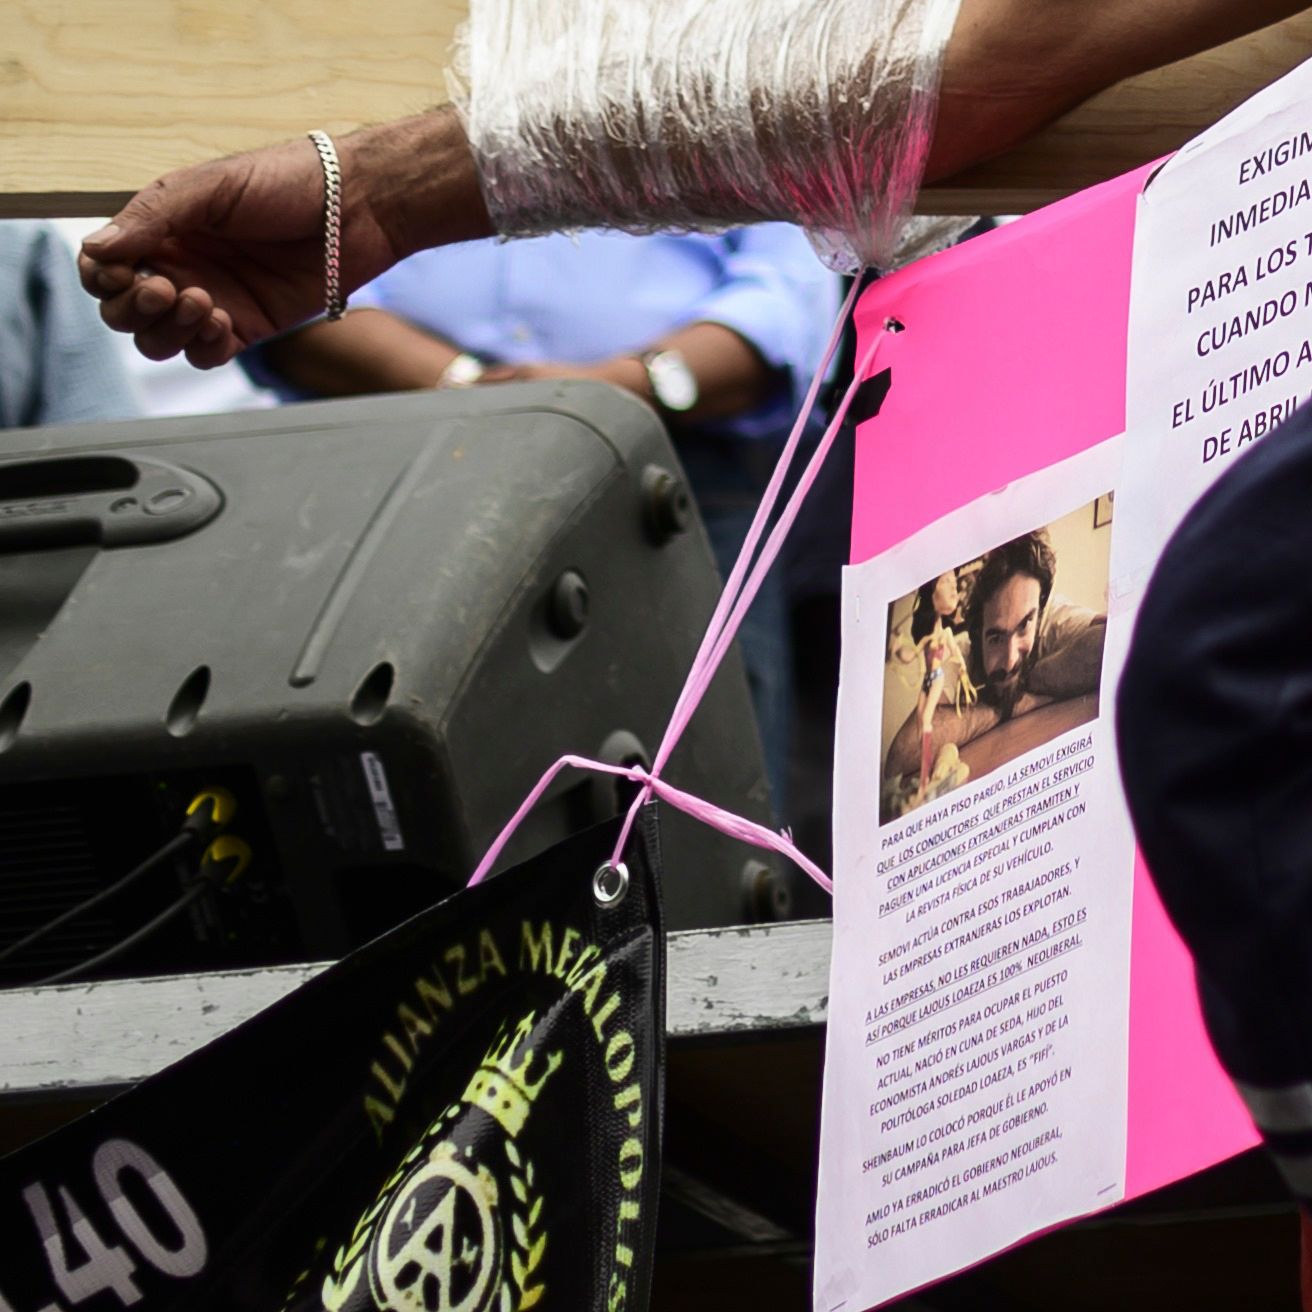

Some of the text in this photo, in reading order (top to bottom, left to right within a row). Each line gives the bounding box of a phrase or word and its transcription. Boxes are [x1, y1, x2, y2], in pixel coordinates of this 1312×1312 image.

[1187, 266, 1248, 313] PARA
[1255, 240, 1297, 280] LOS
[1196, 291, 1297, 356] CUANDO
[1172, 399, 1194, 428] EL
[1201, 351, 1290, 412] ÚLTIMO
[1202, 428, 1231, 463] DE
[876, 756, 1094, 873] QUE LOS CONDUCTORES QUE PRESTAN EL SERVICIO
[881, 734, 1092, 849] PARA QUE HAYA PISO PAREJO, LA SEMOVI EXIGIRÁ
[886, 784, 1080, 890] CON APLICACIONES EXTRANJERAS TRAMITEN Y
[878, 802, 1085, 915] PAGUEN UNA LICENCIA ESPECIAL Y CUMPLAN CON
[878, 858, 1080, 966] SEMOVI ACTÚA CONTRA ESOS TRABAJADORES, Y
[883, 886, 1071, 985] LAS EMPRESAS EXTRANJERAS LOS EXPLOTAN.
[364, 928, 507, 1149] ALIANZA
[870, 1015, 1068, 1116] ECONOMISTA ANDRÉS LAJOUS VARGAS Y DE LA
[876, 970, 1068, 1067] NO TIENE MÉRITOS PARA OCUPAR EL PUESTO
[862, 1067, 1071, 1173] SHEINBAUM LO COLOCÓ PORQUE ÉL LE APOYÓ EN
[881, 1102, 1048, 1187] SU CAMPAÑA PARA JEFA DE GOBIERNO.
[865, 1127, 1062, 1225] AMLO YA ERRADICÓ EL GOBIERNO NEOLIBERAL,
